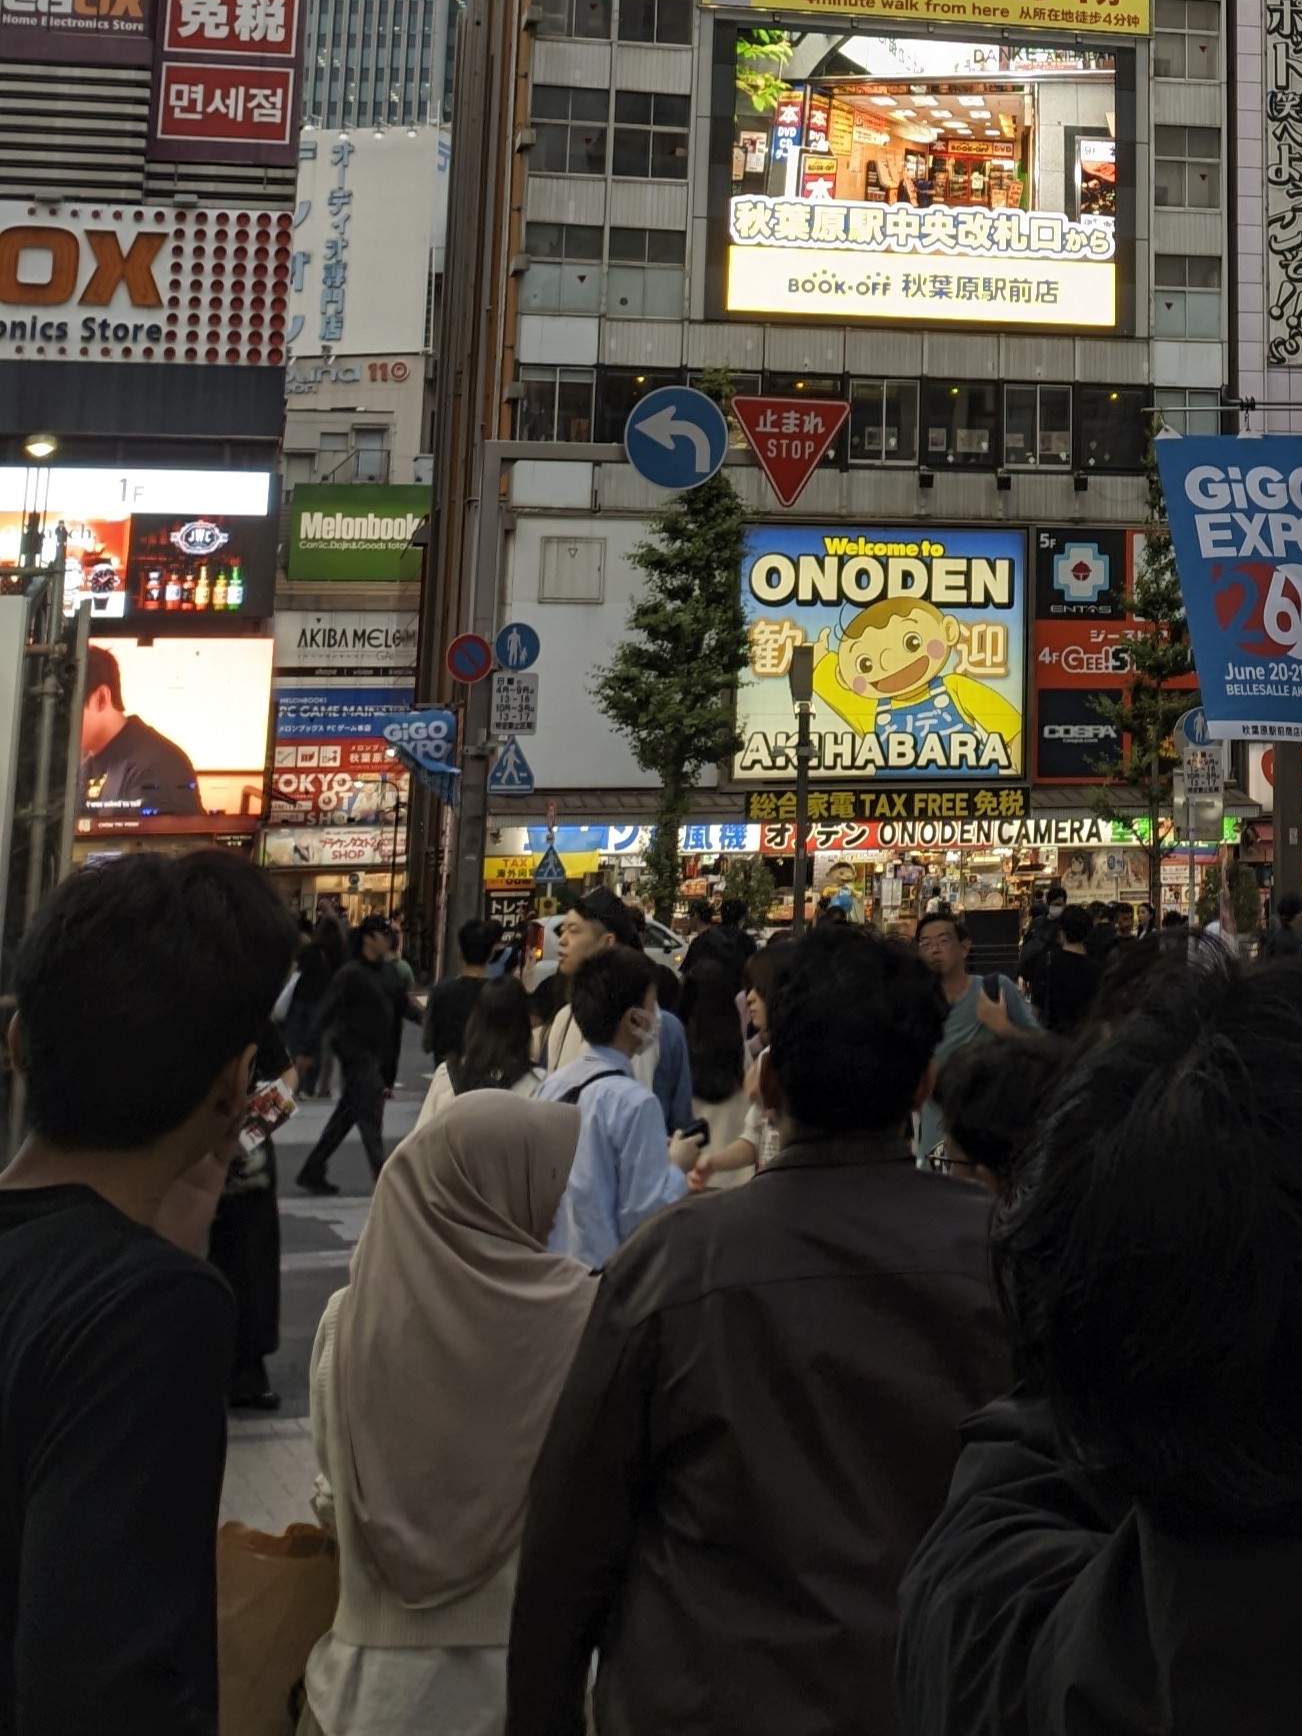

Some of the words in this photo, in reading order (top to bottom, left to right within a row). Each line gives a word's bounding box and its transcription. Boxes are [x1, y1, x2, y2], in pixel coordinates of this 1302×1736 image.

[971, 1, 1010, 20] here
[2, 13, 36, 27] Home
[112, 18, 145, 32] Store
[169, 83, 284, 124] 면세점
[778, 104, 801, 125] 本
[734, 201, 1111, 255] 秋葉原駅中央改札口から
[320, 142, 354, 341] オーディオ専門店
[903, 273, 1059, 304] 秋葉原駅前店
[80, 316, 163, 344] Store
[755, 407, 825, 435] 止まれ
[767, 439, 815, 460] STOP
[119, 478, 144, 502] 1F
[825, 536, 918, 557] Welcome
[922, 540, 944, 558] to
[1039, 533, 1057, 549] 5F
[750, 555, 1011, 606] ONODEN
[751, 620, 804, 675] 歓
[956, 624, 1006, 675] 迎
[1038, 646, 1060, 665] 4F
[1225, 662, 1265, 680] June
[1226, 684, 1289, 697] BELLESALLE
[383, 720, 448, 743] GiGO
[1043, 725, 1117, 739] COSPA
[750, 792, 855, 820] 総合家電
[861, 793, 906, 817] TAX
[913, 792, 968, 817] FREE
[973, 789, 1025, 817] 免税
[878, 821, 992, 846] ONODEN
[997, 819, 1102, 845] CAMERA
[331, 849, 365, 860] SHOP
